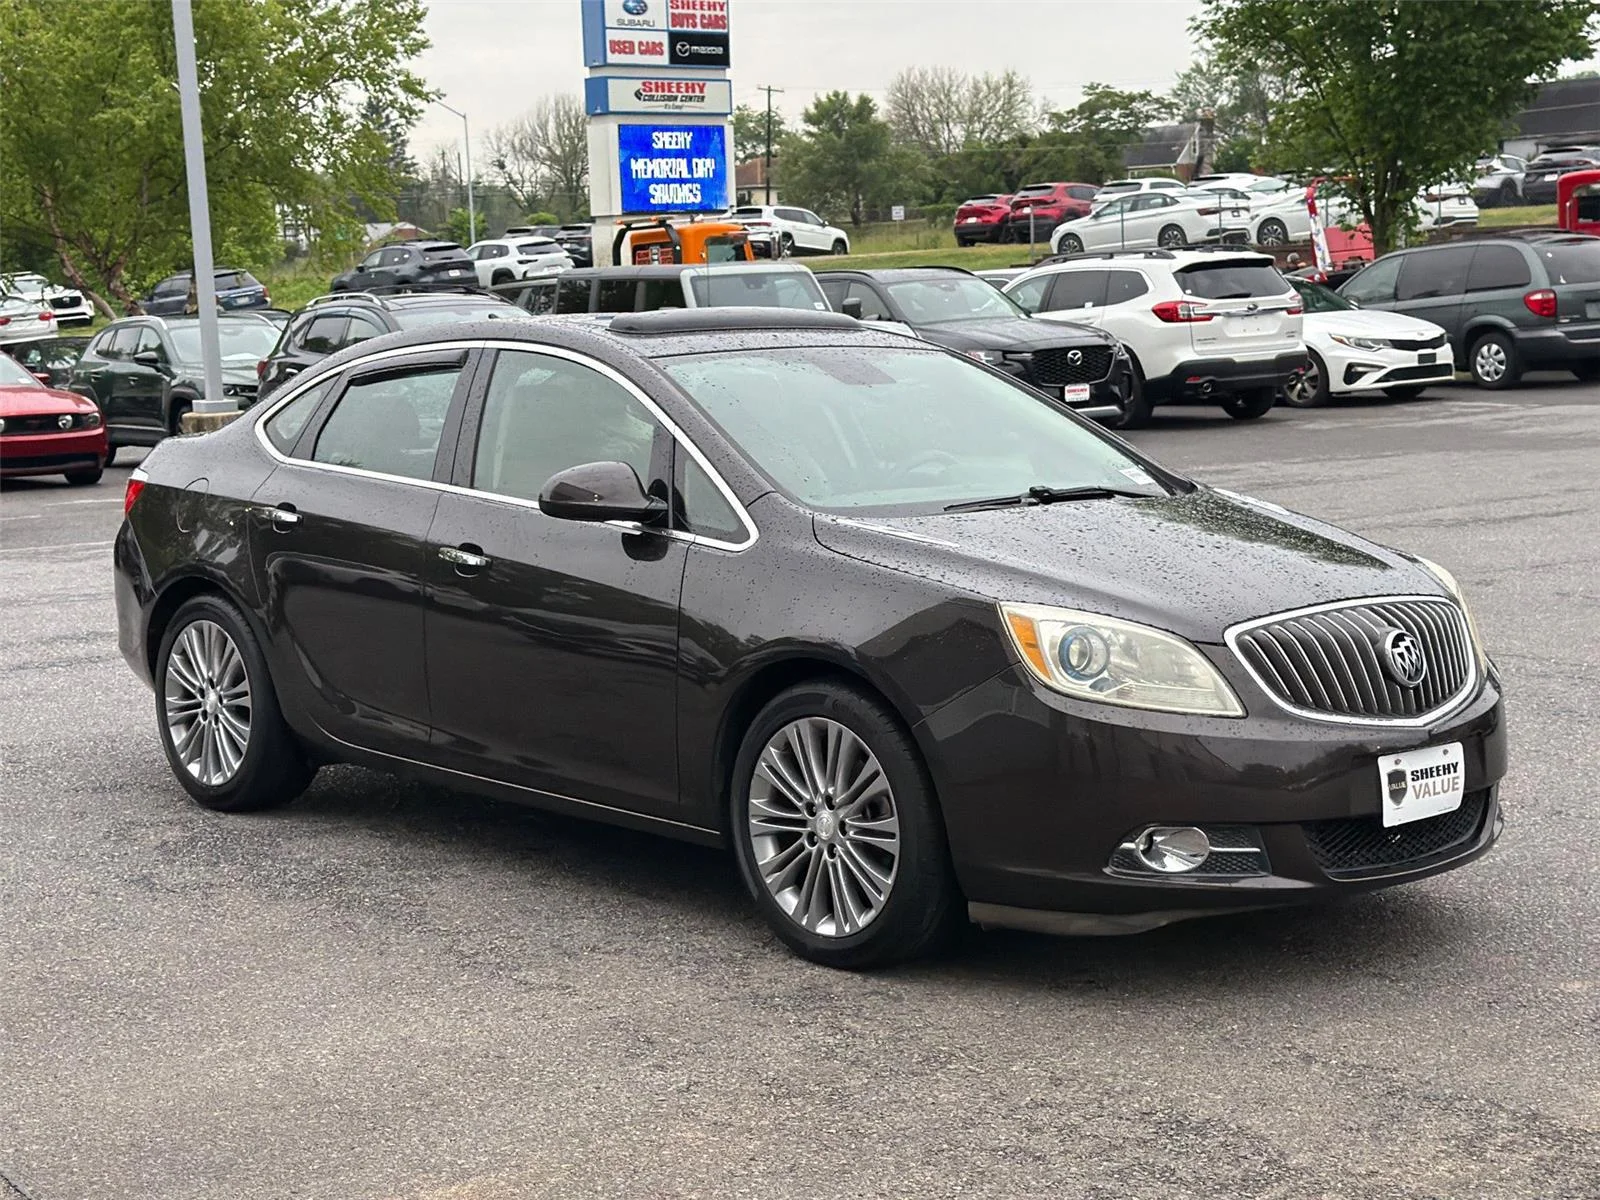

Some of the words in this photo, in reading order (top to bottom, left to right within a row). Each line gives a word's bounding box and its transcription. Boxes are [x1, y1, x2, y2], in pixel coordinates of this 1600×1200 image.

[670, 0, 725, 11] SHEEHY
[616, 18, 655, 27] SUBARU
[671, 12, 697, 28] BUYS
[700, 13, 727, 30] CARS
[609, 40, 634, 55] USED
[638, 41, 664, 56] CARS
[691, 45, 723, 54] mazda
[641, 81, 706, 94] SHEEHY
[642, 94, 678, 102] COLLISION
[681, 95, 705, 103] CENTER
[652, 131, 693, 149] SHEEHY
[630, 157, 691, 179] MEMORIAL
[692, 158, 715, 178] DAY
[649, 183, 701, 204] SAVINGS
[1410, 761, 1459, 782] SHEEHY
[1412, 776, 1460, 800] VALUE
